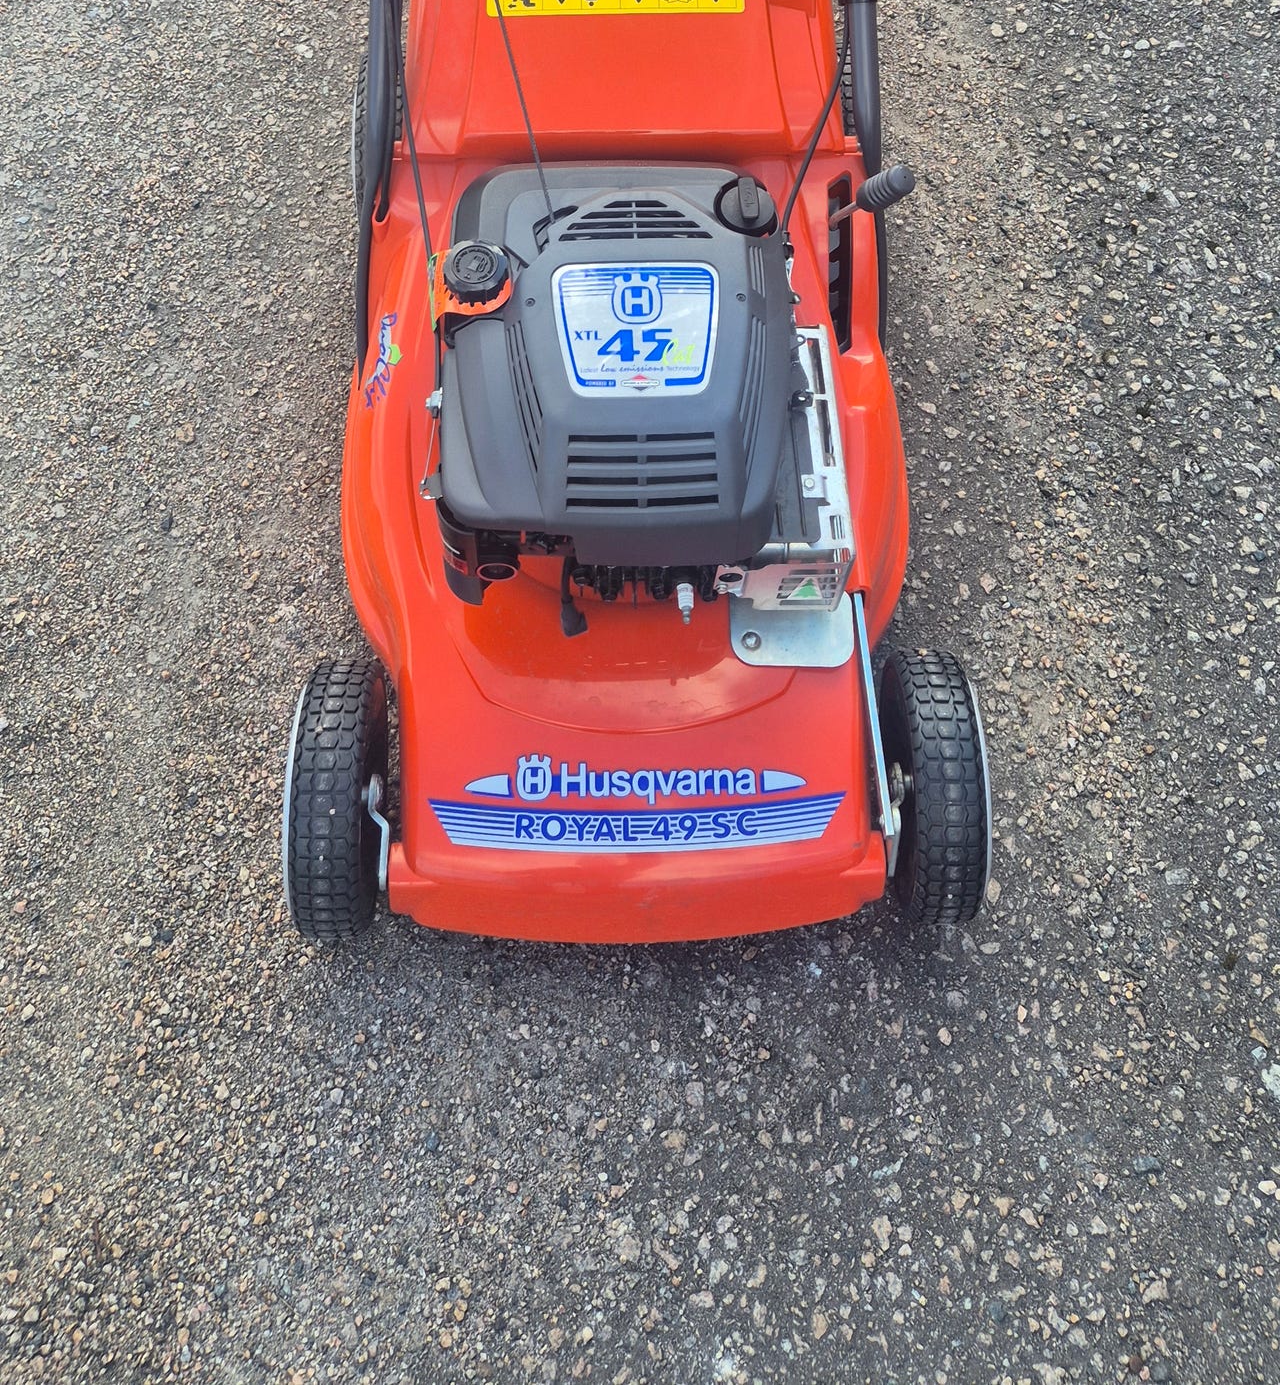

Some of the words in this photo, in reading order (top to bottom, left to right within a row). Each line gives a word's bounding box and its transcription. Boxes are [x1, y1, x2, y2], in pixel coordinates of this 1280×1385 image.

[574, 330, 602, 341] XTL
[597, 329, 673, 362] 45
[560, 762, 757, 805] Husqvarna
[515, 813, 639, 843] ROYAL
[650, 814, 698, 842] 49
[711, 810, 759, 839] SC
